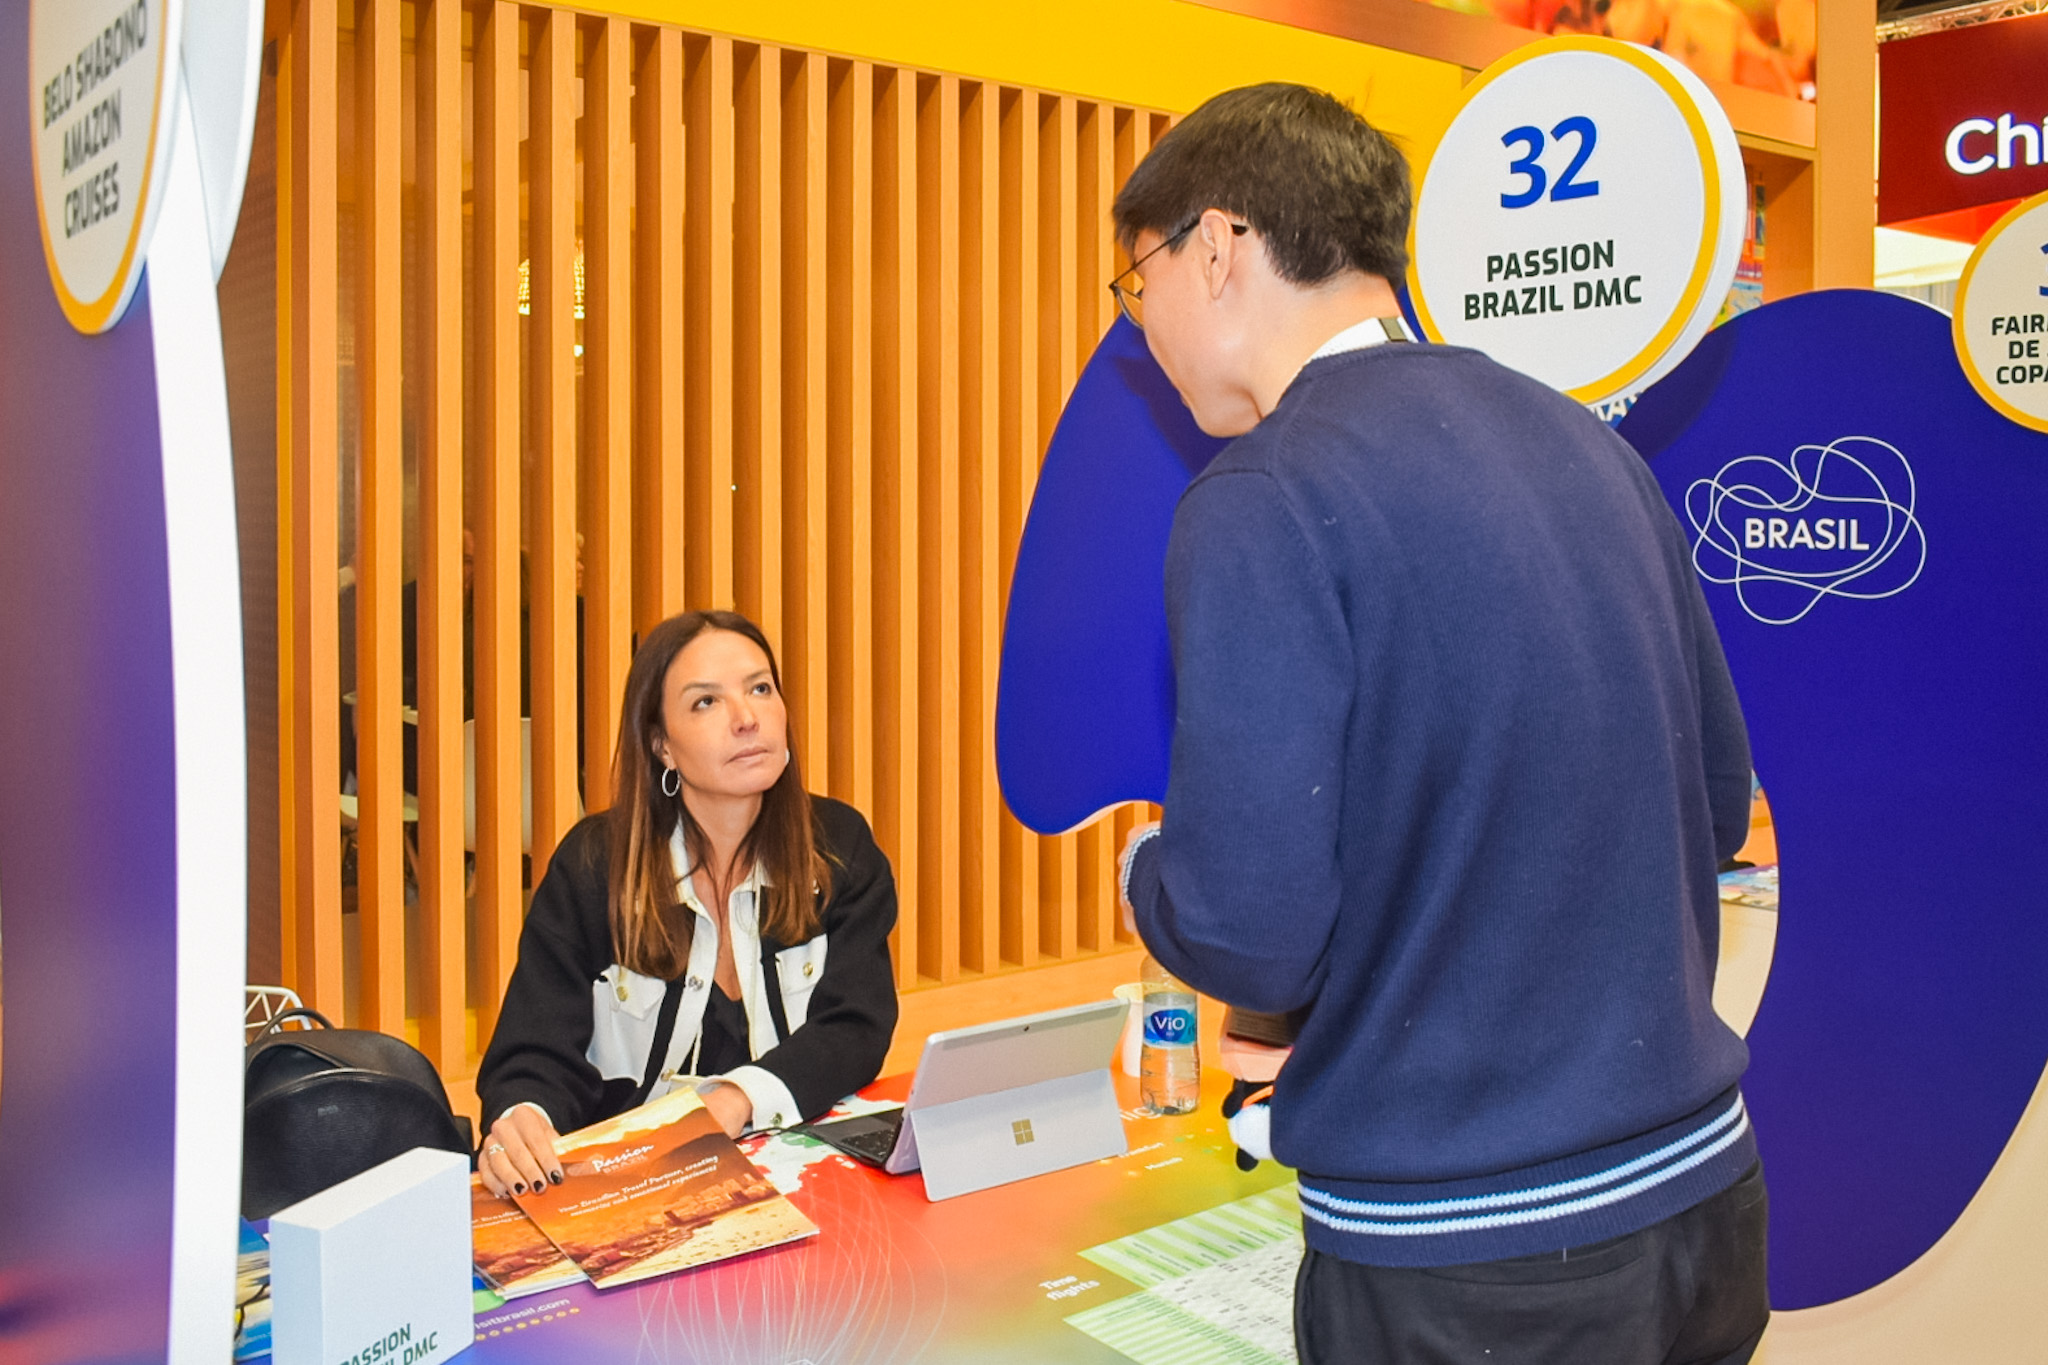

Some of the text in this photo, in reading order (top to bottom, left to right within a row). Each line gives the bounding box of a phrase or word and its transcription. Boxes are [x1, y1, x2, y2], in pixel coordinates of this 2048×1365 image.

[44, 0, 148, 130] BELO SHABONO
[62, 86, 121, 177] AMAZON
[1500, 116, 1600, 209] 32
[65, 161, 119, 239] CRUISES
[1487, 239, 1614, 283] PASSION
[1464, 275, 1642, 321] BRAZIL DMC
[1991, 314, 2048, 336] FAIR
[2009, 340, 2039, 359] DE
[1996, 365, 2048, 384] COP
[1744, 518, 1870, 552] BRASIL
[1154, 1015, 1186, 1031] ViO
[592, 1144, 654, 1172] Passion
[622, 1180, 648, 1194] Travel
[685, 1155, 719, 1172] creating
[474, 1298, 571, 1329] isitbrasil.com
[338, 1322, 411, 1365] ASSION
[403, 1331, 438, 1365] DMC
